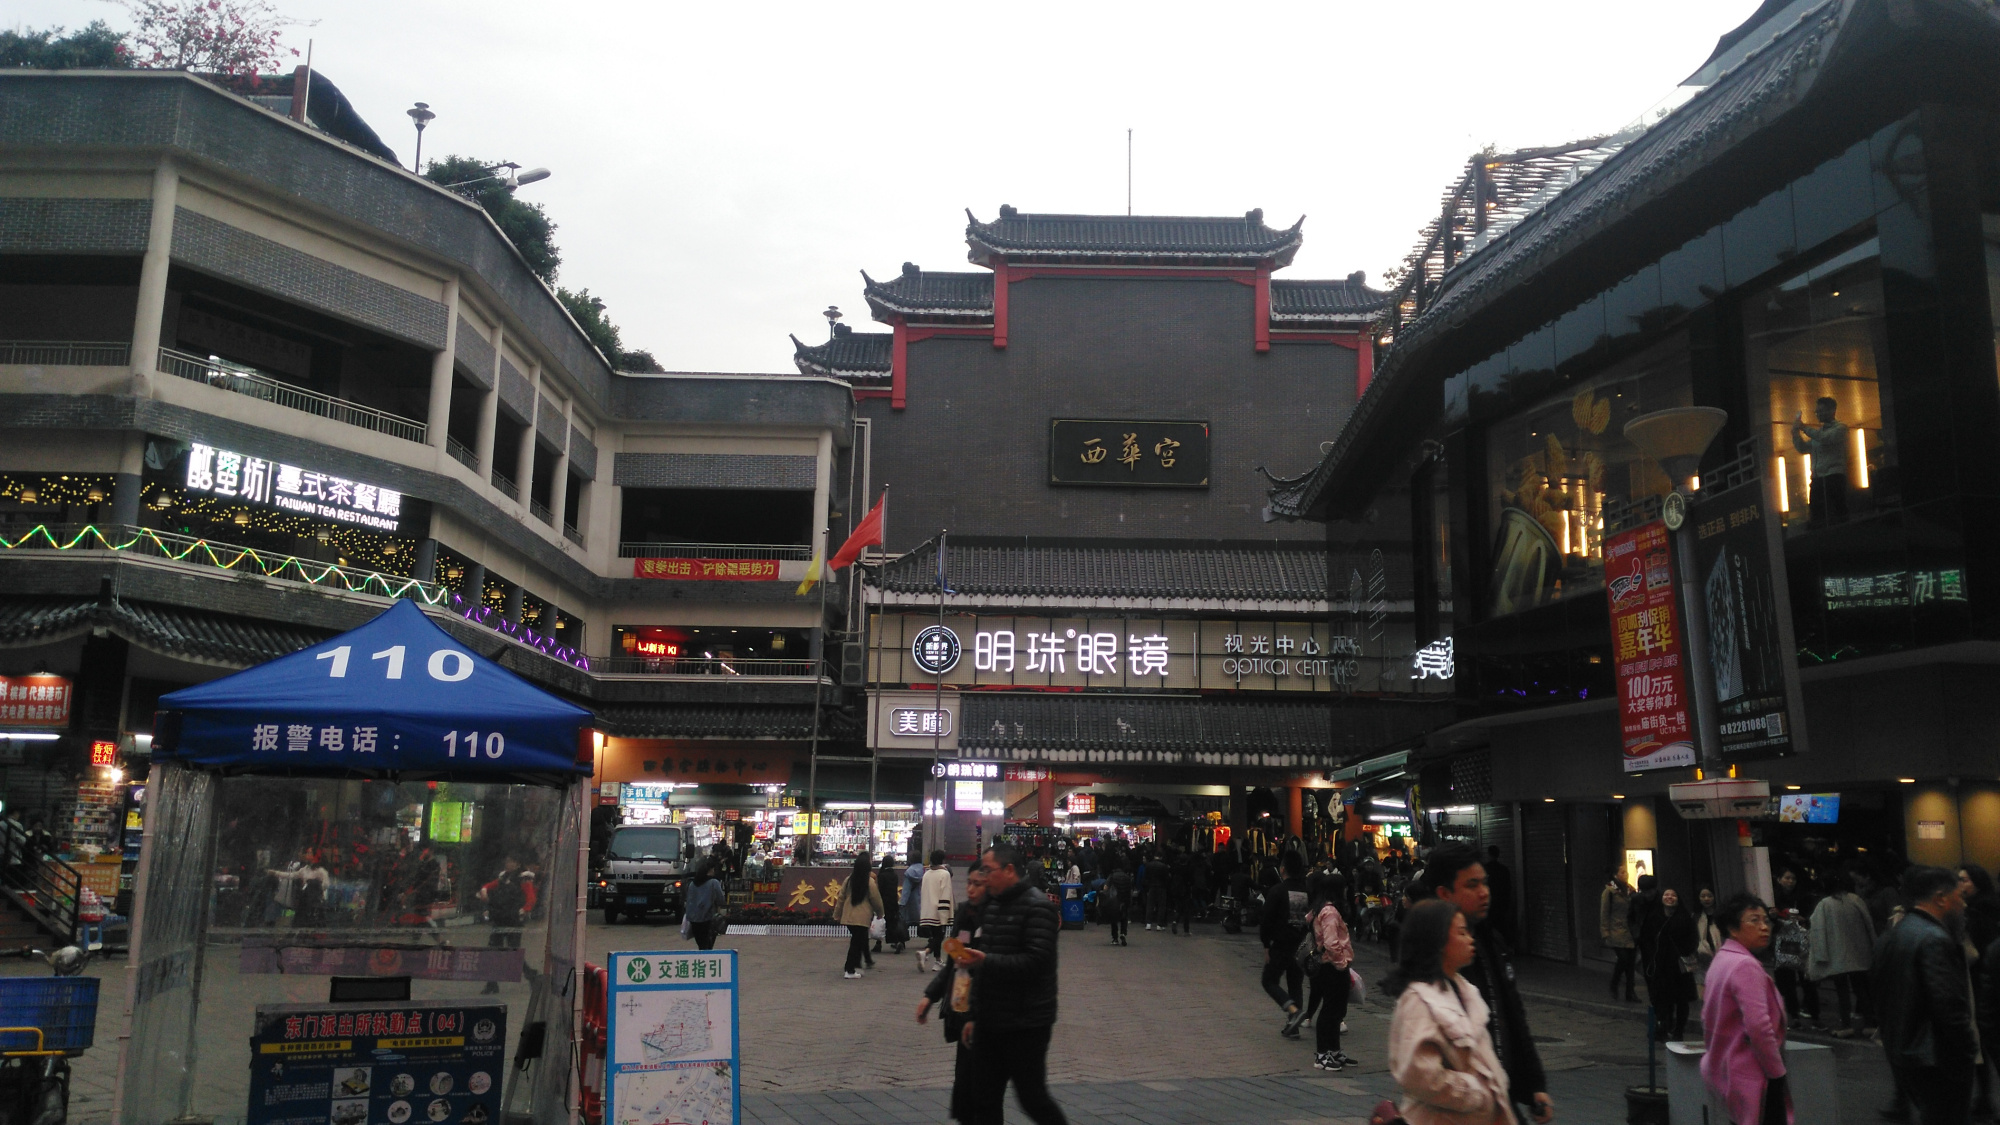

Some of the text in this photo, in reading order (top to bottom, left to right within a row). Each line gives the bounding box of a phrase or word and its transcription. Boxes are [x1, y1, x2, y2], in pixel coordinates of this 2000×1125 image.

[275, 495, 399, 531] TAIWAN TEA RESTAURANT
[1224, 633, 1321, 655] 视光中心
[1618, 622, 1673, 660] 嘉年华
[316, 645, 475, 682] 110
[1627, 674, 1673, 699] 100万元
[899, 711, 943, 733] 美瞳
[1727, 716, 1767, 735] 82281088
[93, 743, 114, 755] 香烟
[443, 730, 505, 759] 110
[92, 753, 112, 764] 饮料
[658, 958, 722, 979] 交通指引
